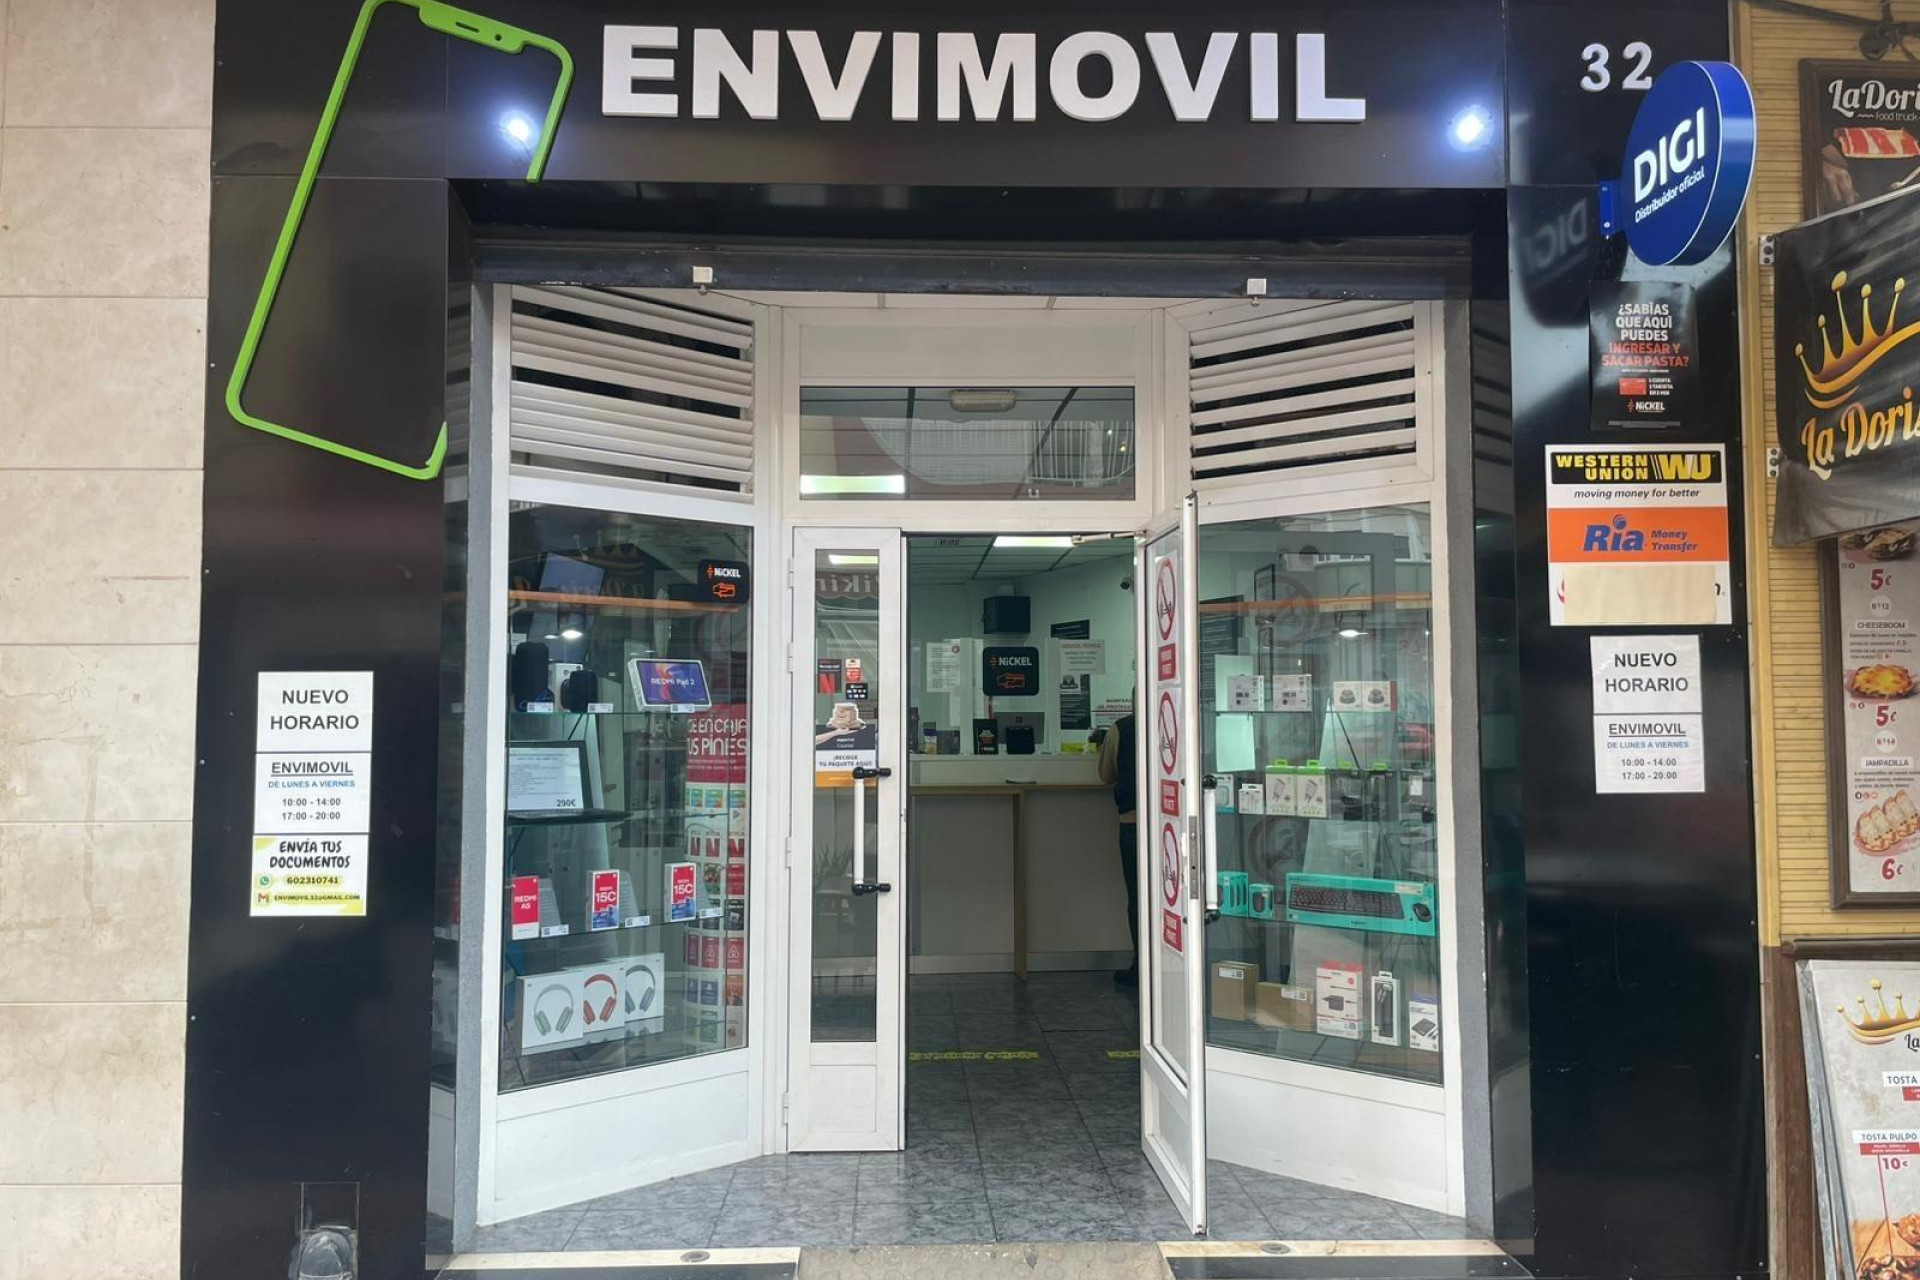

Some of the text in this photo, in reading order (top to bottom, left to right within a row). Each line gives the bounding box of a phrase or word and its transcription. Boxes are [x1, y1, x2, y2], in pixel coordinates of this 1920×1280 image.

[1580, 41, 1653, 92] 32
[602, 25, 1366, 122] ENVIMOVIL
[1634, 107, 1705, 203] DIGI
[1635, 165, 1705, 223] Distribuidor oficial
[1618, 301, 1669, 315] ¿SABÍAS
[1615, 315, 1673, 329] QUE AQUÍ
[1620, 329, 1669, 341] PUEDES
[1609, 342, 1681, 354] INGRESAR Y
[1602, 355, 1689, 367] SACAR PASTA?
[1801, 417, 1835, 481] La
[1555, 454, 1712, 480] WESTERN WU
[1584, 468, 1649, 481] UNION
[1573, 488, 1700, 499] moving money for better
[1583, 514, 1644, 551] Ria
[1651, 530, 1687, 540] Money
[1651, 542, 1698, 553] Transfer
[1614, 653, 1677, 667] NUEVO
[651, 677, 675, 685] REDMI
[1605, 678, 1688, 692] HORARIO
[282, 690, 349, 705] NUEVO
[270, 715, 359, 730] HORARIO
[1608, 723, 1686, 735] ENVIMOVIL
[271, 761, 353, 774] ENVIMOVIL
[1653, 758, 1677, 766] 14:00
[1622, 772, 1645, 780] 17:00
[1653, 772, 1677, 780] 20:00
[320, 780, 355, 788] VIERNES
[282, 798, 307, 806] 10:00
[316, 798, 341, 806] 14:00
[282, 812, 307, 820] 17:00
[315, 812, 340, 820] 20:00
[279, 839, 342, 853] ENVÍA TUS
[269, 855, 350, 869] DOCUMENTOS
[286, 876, 339, 885] 602310741
[674, 883, 693, 895] 15C
[595, 890, 617, 903] 15C
[1886, 1075, 1918, 1085] TOSTA
[1862, 1131, 1917, 1141] TOSTA PULPO
[1882, 1157, 1909, 1170] 10€
